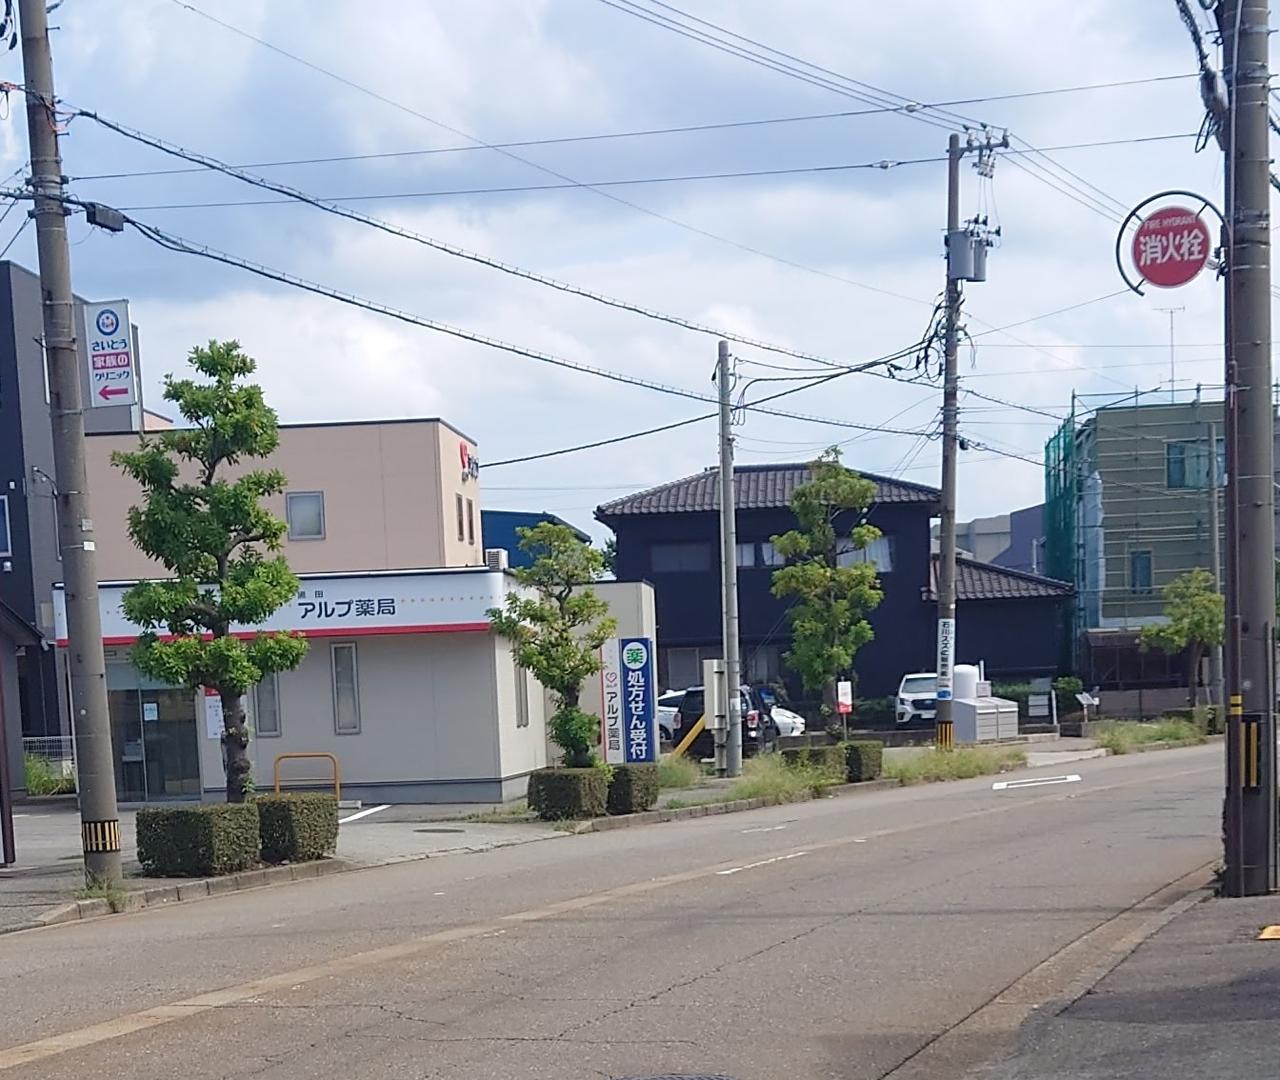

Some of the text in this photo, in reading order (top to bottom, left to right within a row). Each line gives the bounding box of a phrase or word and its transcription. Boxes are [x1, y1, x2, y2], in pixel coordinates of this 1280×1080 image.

[1139, 228, 1204, 266] 消火栓
[91, 339, 128, 351] さいとう
[93, 354, 128, 368] 家族の
[95, 371, 130, 382] クリニック
[297, 598, 396, 619] アルプ薬局
[626, 648, 644, 665] 薬
[606, 691, 621, 751] アルプ薬局
[627, 670, 648, 759] 処方せん受付
